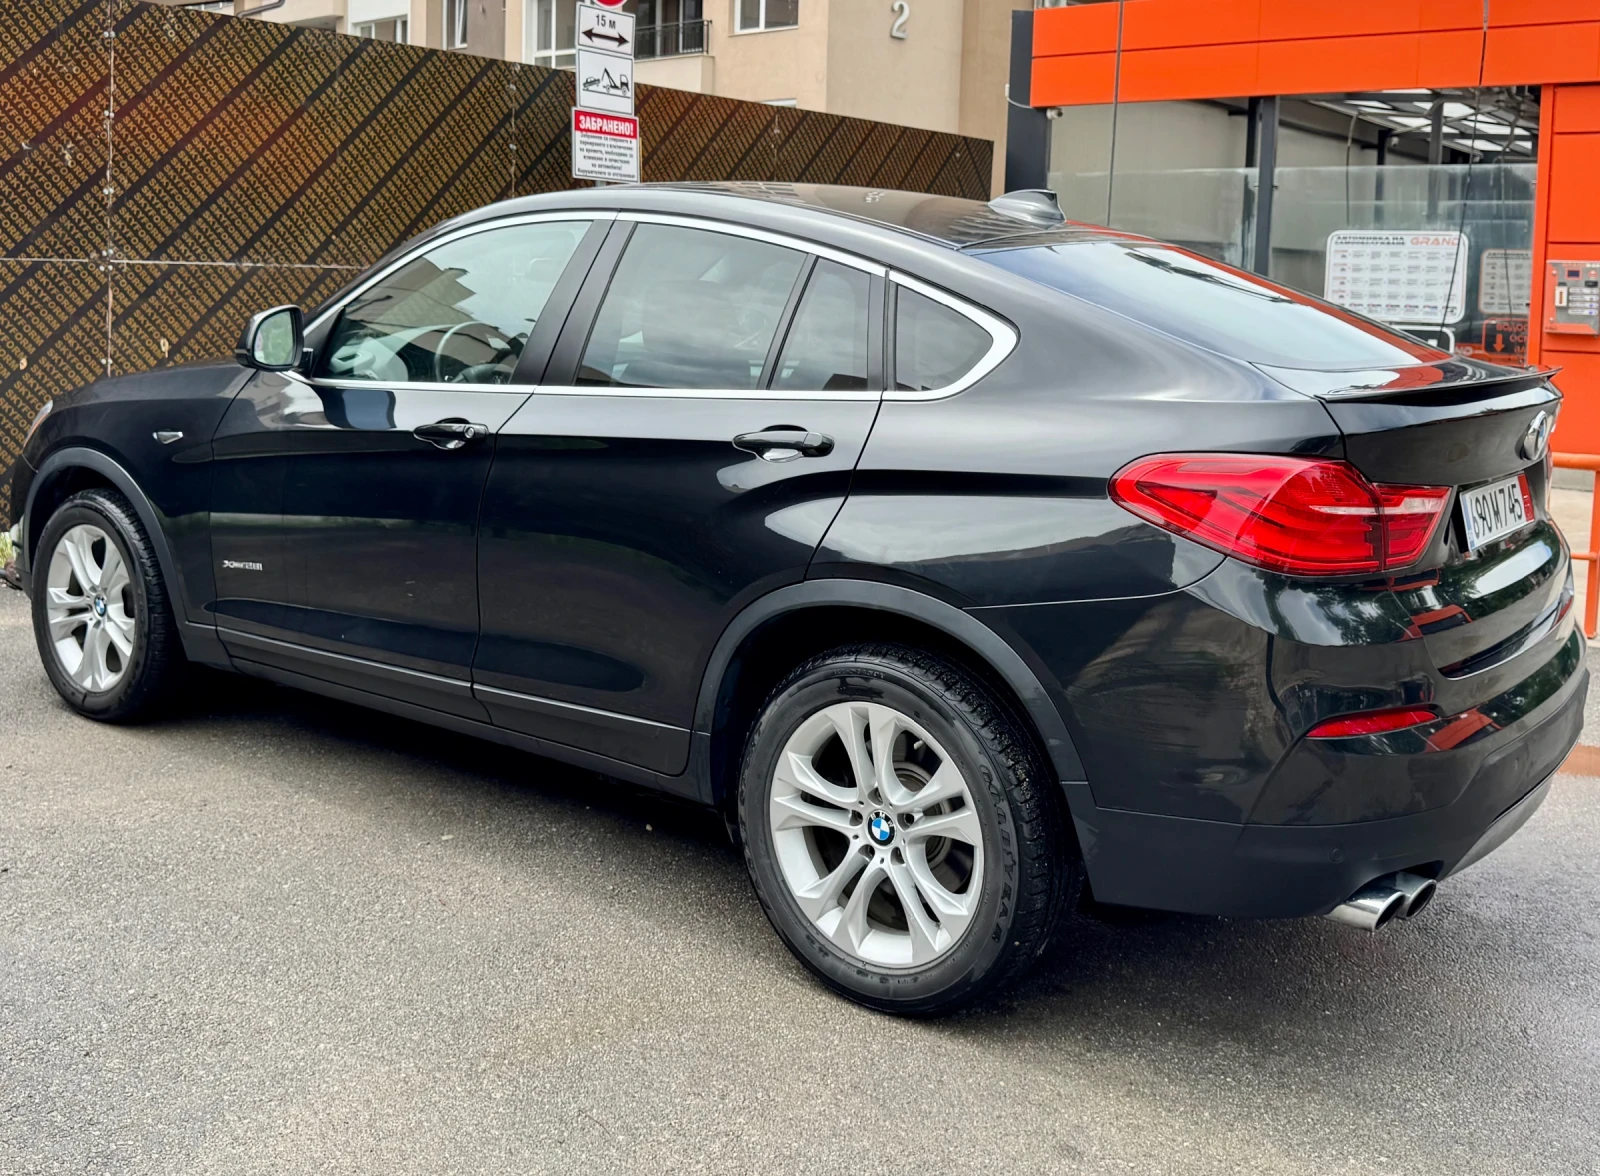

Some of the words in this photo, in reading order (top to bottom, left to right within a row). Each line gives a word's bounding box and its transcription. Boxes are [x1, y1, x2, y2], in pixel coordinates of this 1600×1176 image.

[134, 18, 171, 65] SKYFORM
[141, 11, 178, 58] SKYFORM
[148, 5, 186, 51] SKYFORM
[230, 17, 264, 62] SKYFORM
[596, 14, 606, 27] 15
[892, 0, 910, 40] 2
[52, 41, 92, 89] SKYFORM
[60, 34, 100, 82] SKYFORM
[68, 27, 108, 75] SKYFORM
[119, 31, 157, 78] SKYFORM
[126, 24, 164, 71] SKYFORM
[202, 42, 238, 87] SKYFORM
[209, 36, 244, 81] SKYFORM
[216, 30, 251, 74] SKYFORM
[223, 23, 258, 68] SKYFORM
[19, 69, 60, 117] SKYFORM
[27, 62, 68, 110] SKYFORM
[36, 54, 76, 102] SKYFORM
[44, 48, 84, 95] SKYFORM
[174, 68, 210, 113] SKYFORM
[181, 62, 217, 107] SKYFORM
[188, 55, 224, 100] SKYFORM
[196, 49, 231, 94] SKYFORM
[2, 83, 44, 131] SKYFORM
[10, 76, 52, 124] SKYFORM
[145, 95, 182, 140] SKYFORM
[152, 88, 189, 134] SKYFORM
[160, 82, 196, 127] SKYFORM
[167, 75, 203, 120] SKYFORM
[234, 97, 268, 140] SKYFORM
[240, 91, 274, 134] SKYFORM
[64, 121, 104, 167] SKYFORM
[72, 114, 111, 160] SKYFORM
[115, 123, 153, 168] SKYFORM
[122, 116, 160, 161] SKYFORM
[130, 109, 168, 154] SKYFORM
[137, 102, 175, 147] SKYFORM
[206, 123, 241, 167] SKYFORM
[213, 117, 248, 160] SKYFORM
[220, 110, 255, 153] SKYFORM
[227, 104, 261, 147] SKYFORM
[579, 115, 634, 136] ЗАБРАНЕНО!
[31, 150, 72, 196] SKYFORM
[39, 142, 80, 189] SKYFORM
[178, 150, 214, 194] SKYFORM
[185, 144, 221, 187] SKYFORM
[192, 137, 228, 180] SKYFORM
[199, 130, 235, 173] SKYFORM
[5, 172, 47, 218] SKYFORM
[14, 165, 56, 211] SKYFORM
[22, 157, 64, 204] SKYFORM
[148, 178, 186, 222] SKYFORM
[156, 171, 193, 214] SKYFORM
[163, 164, 200, 208] SKYFORM
[171, 157, 207, 201] SKYFORM
[237, 176, 272, 218] SKYFORM
[126, 199, 164, 243] SKYFORM
[134, 192, 171, 236] SKYFORM
[141, 185, 178, 229] SKYFORM
[210, 204, 245, 246] SKYFORM
[217, 197, 252, 238] SKYFORM
[224, 190, 258, 232] SKYFORM
[230, 183, 265, 225] SKYFORM
[67, 207, 107, 252] SKYFORM
[119, 207, 157, 250] SKYFORM
[196, 217, 231, 259] SKYFORM
[203, 211, 238, 252] SKYFORM
[26, 278, 68, 322] SKYFORM
[35, 270, 76, 314] SKYFORM
[43, 262, 84, 307] SKYFORM
[163, 280, 200, 322] SKYFORM
[170, 273, 207, 315] SKYFORM
[178, 266, 214, 308] SKYFORM
[1, 301, 43, 345] SKYFORM
[10, 293, 52, 337] SKYFORM
[18, 286, 60, 330] SKYFORM
[141, 302, 178, 343] SKYFORM
[148, 294, 186, 336] SKYFORM
[156, 287, 193, 329] SKYFORM
[63, 332, 103, 374] SKYFORM
[118, 324, 156, 366] SKYFORM
[126, 317, 164, 358] SKYFORM
[55, 340, 95, 382] SKYFORM
[870, 812, 894, 827] BMW
